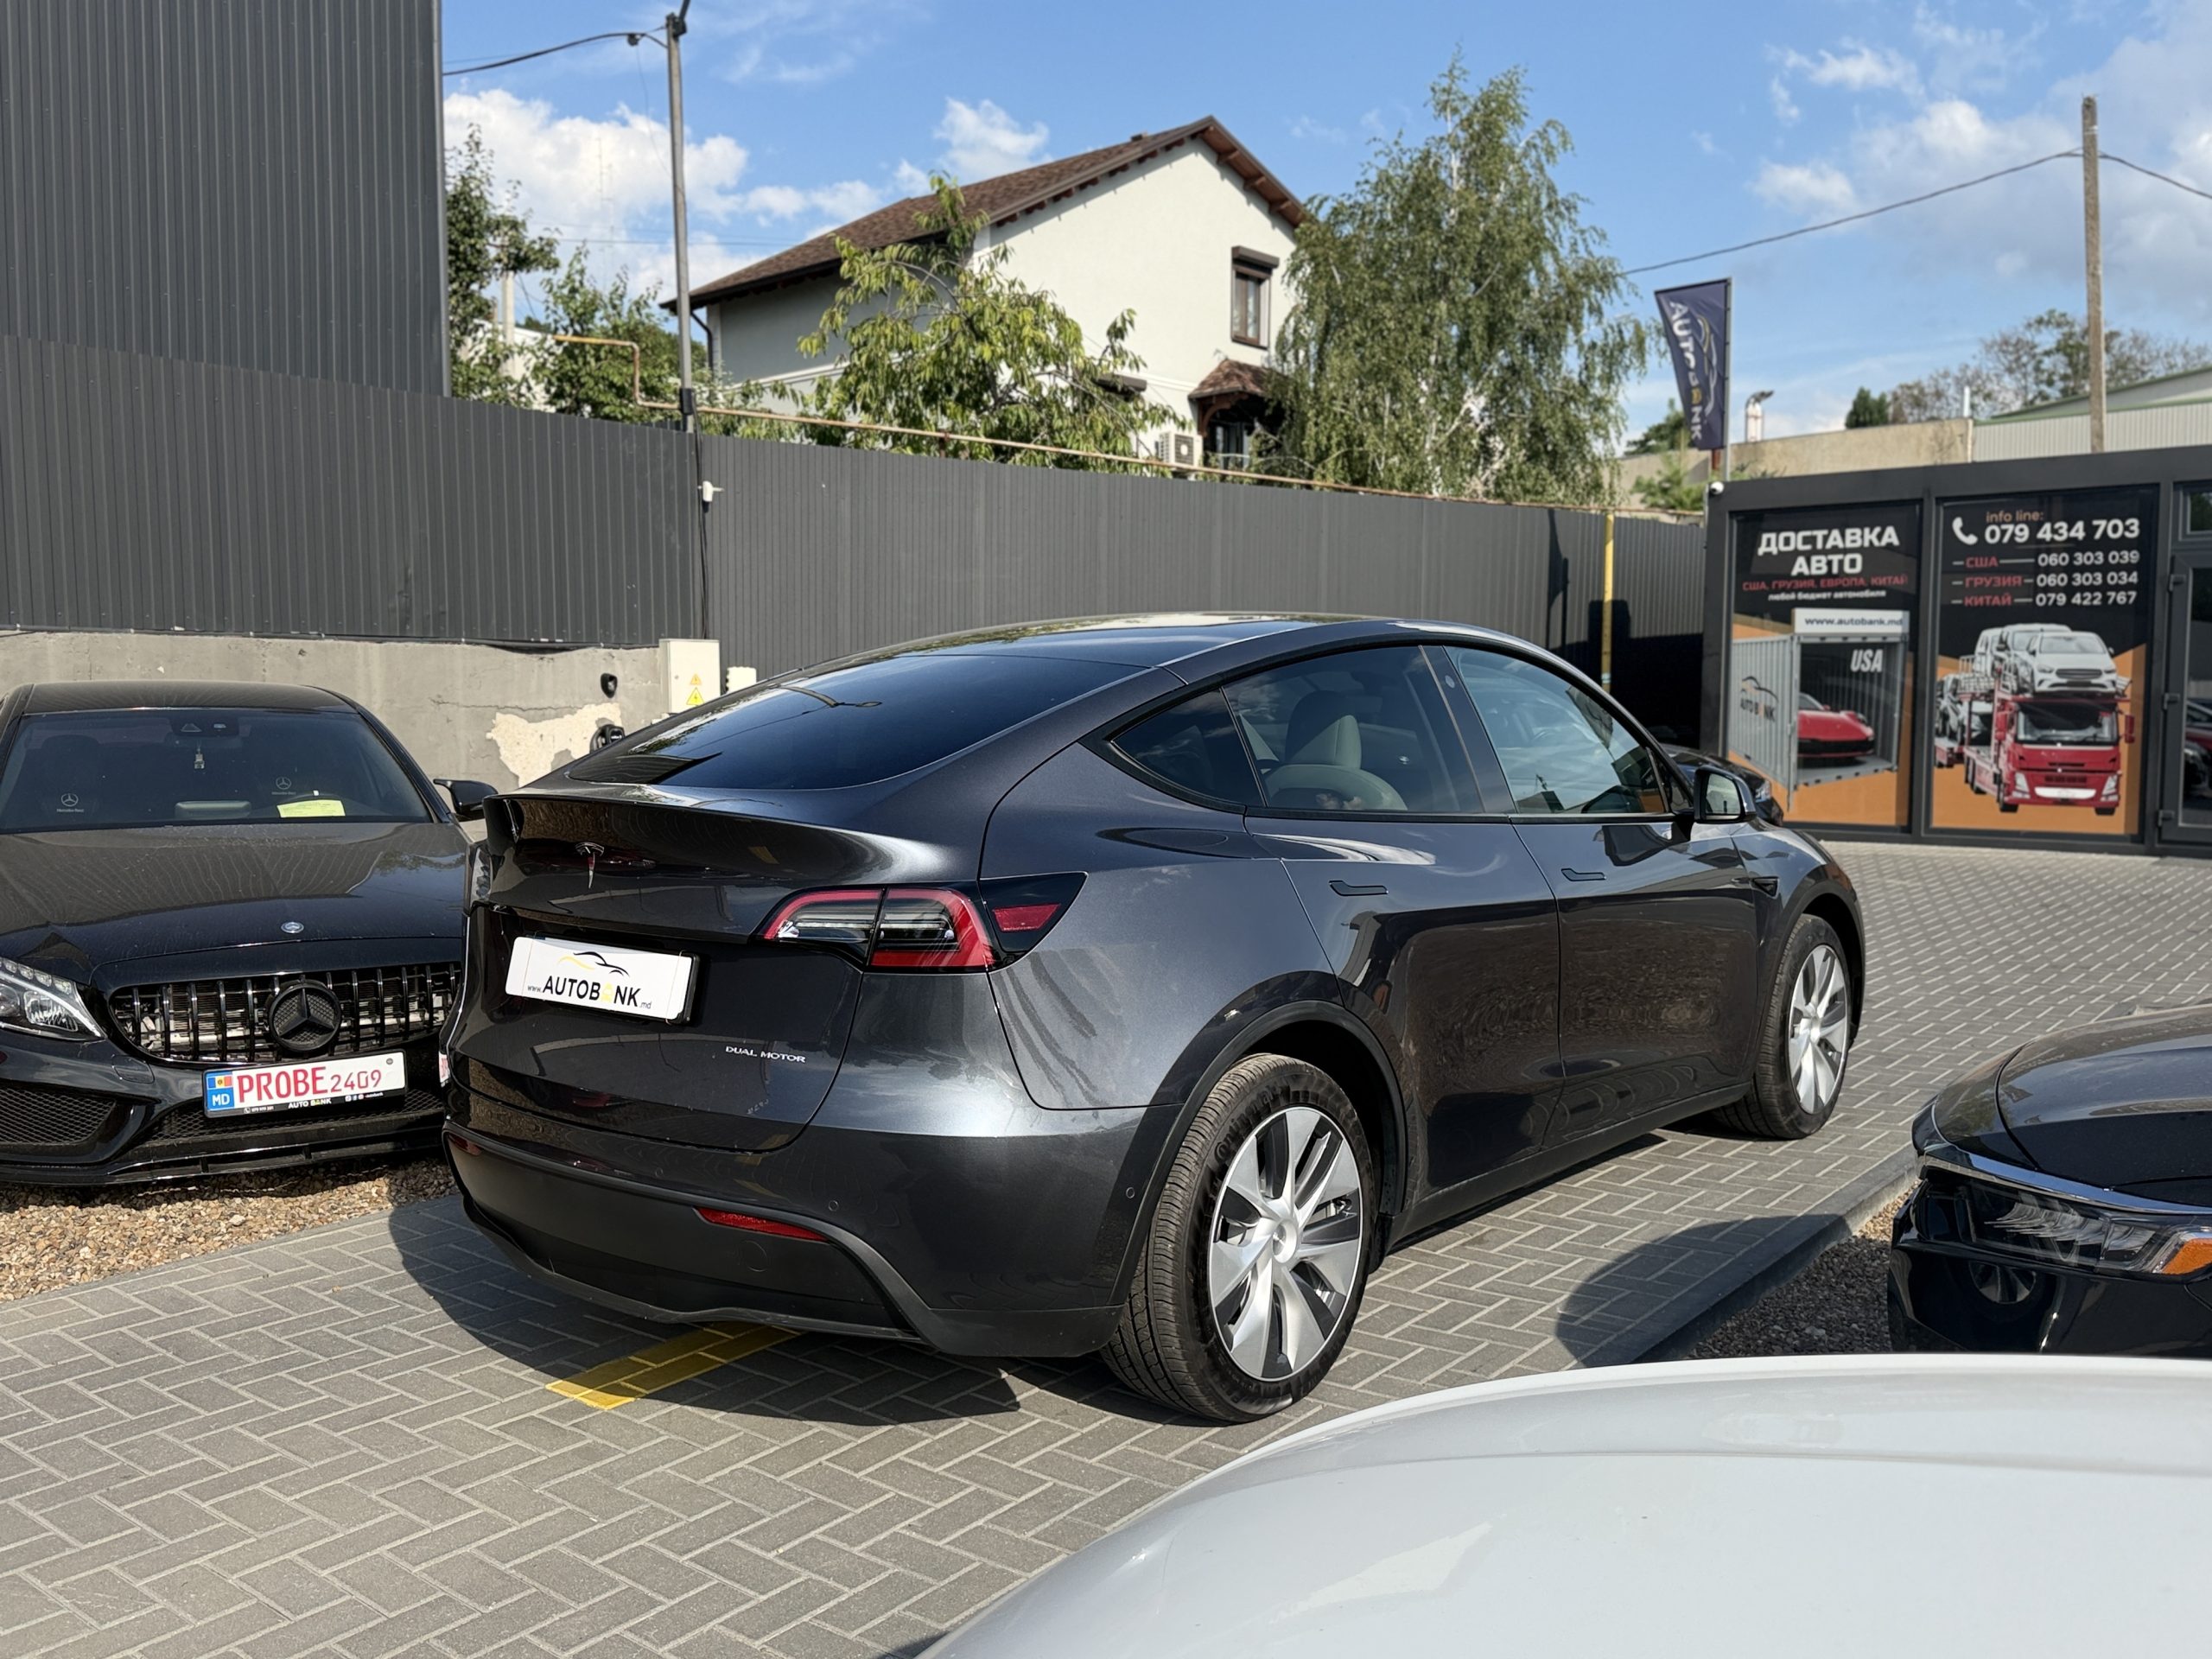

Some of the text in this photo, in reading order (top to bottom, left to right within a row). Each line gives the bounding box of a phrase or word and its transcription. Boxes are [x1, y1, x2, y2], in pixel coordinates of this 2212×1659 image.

[1986, 510, 2044, 523] info line:
[1985, 518, 2140, 543] 079 434 703
[1758, 525, 1899, 556] ДОСТАВКА
[1790, 553, 1863, 576] АВТО
[1965, 550, 2140, 568] США 060 303 039
[1965, 571, 2139, 588] ГРУЗИЯ 060 303 034
[1964, 591, 2137, 607] КИТАЙ 079 422 767
[1805, 616, 1904, 627] www.autobank.md
[1850, 649, 1884, 672] USA
[725, 1046, 806, 1064] DUAL MOTOR
[237, 1066, 382, 1103] PROBE 2409
[212, 1093, 231, 1107] MD
